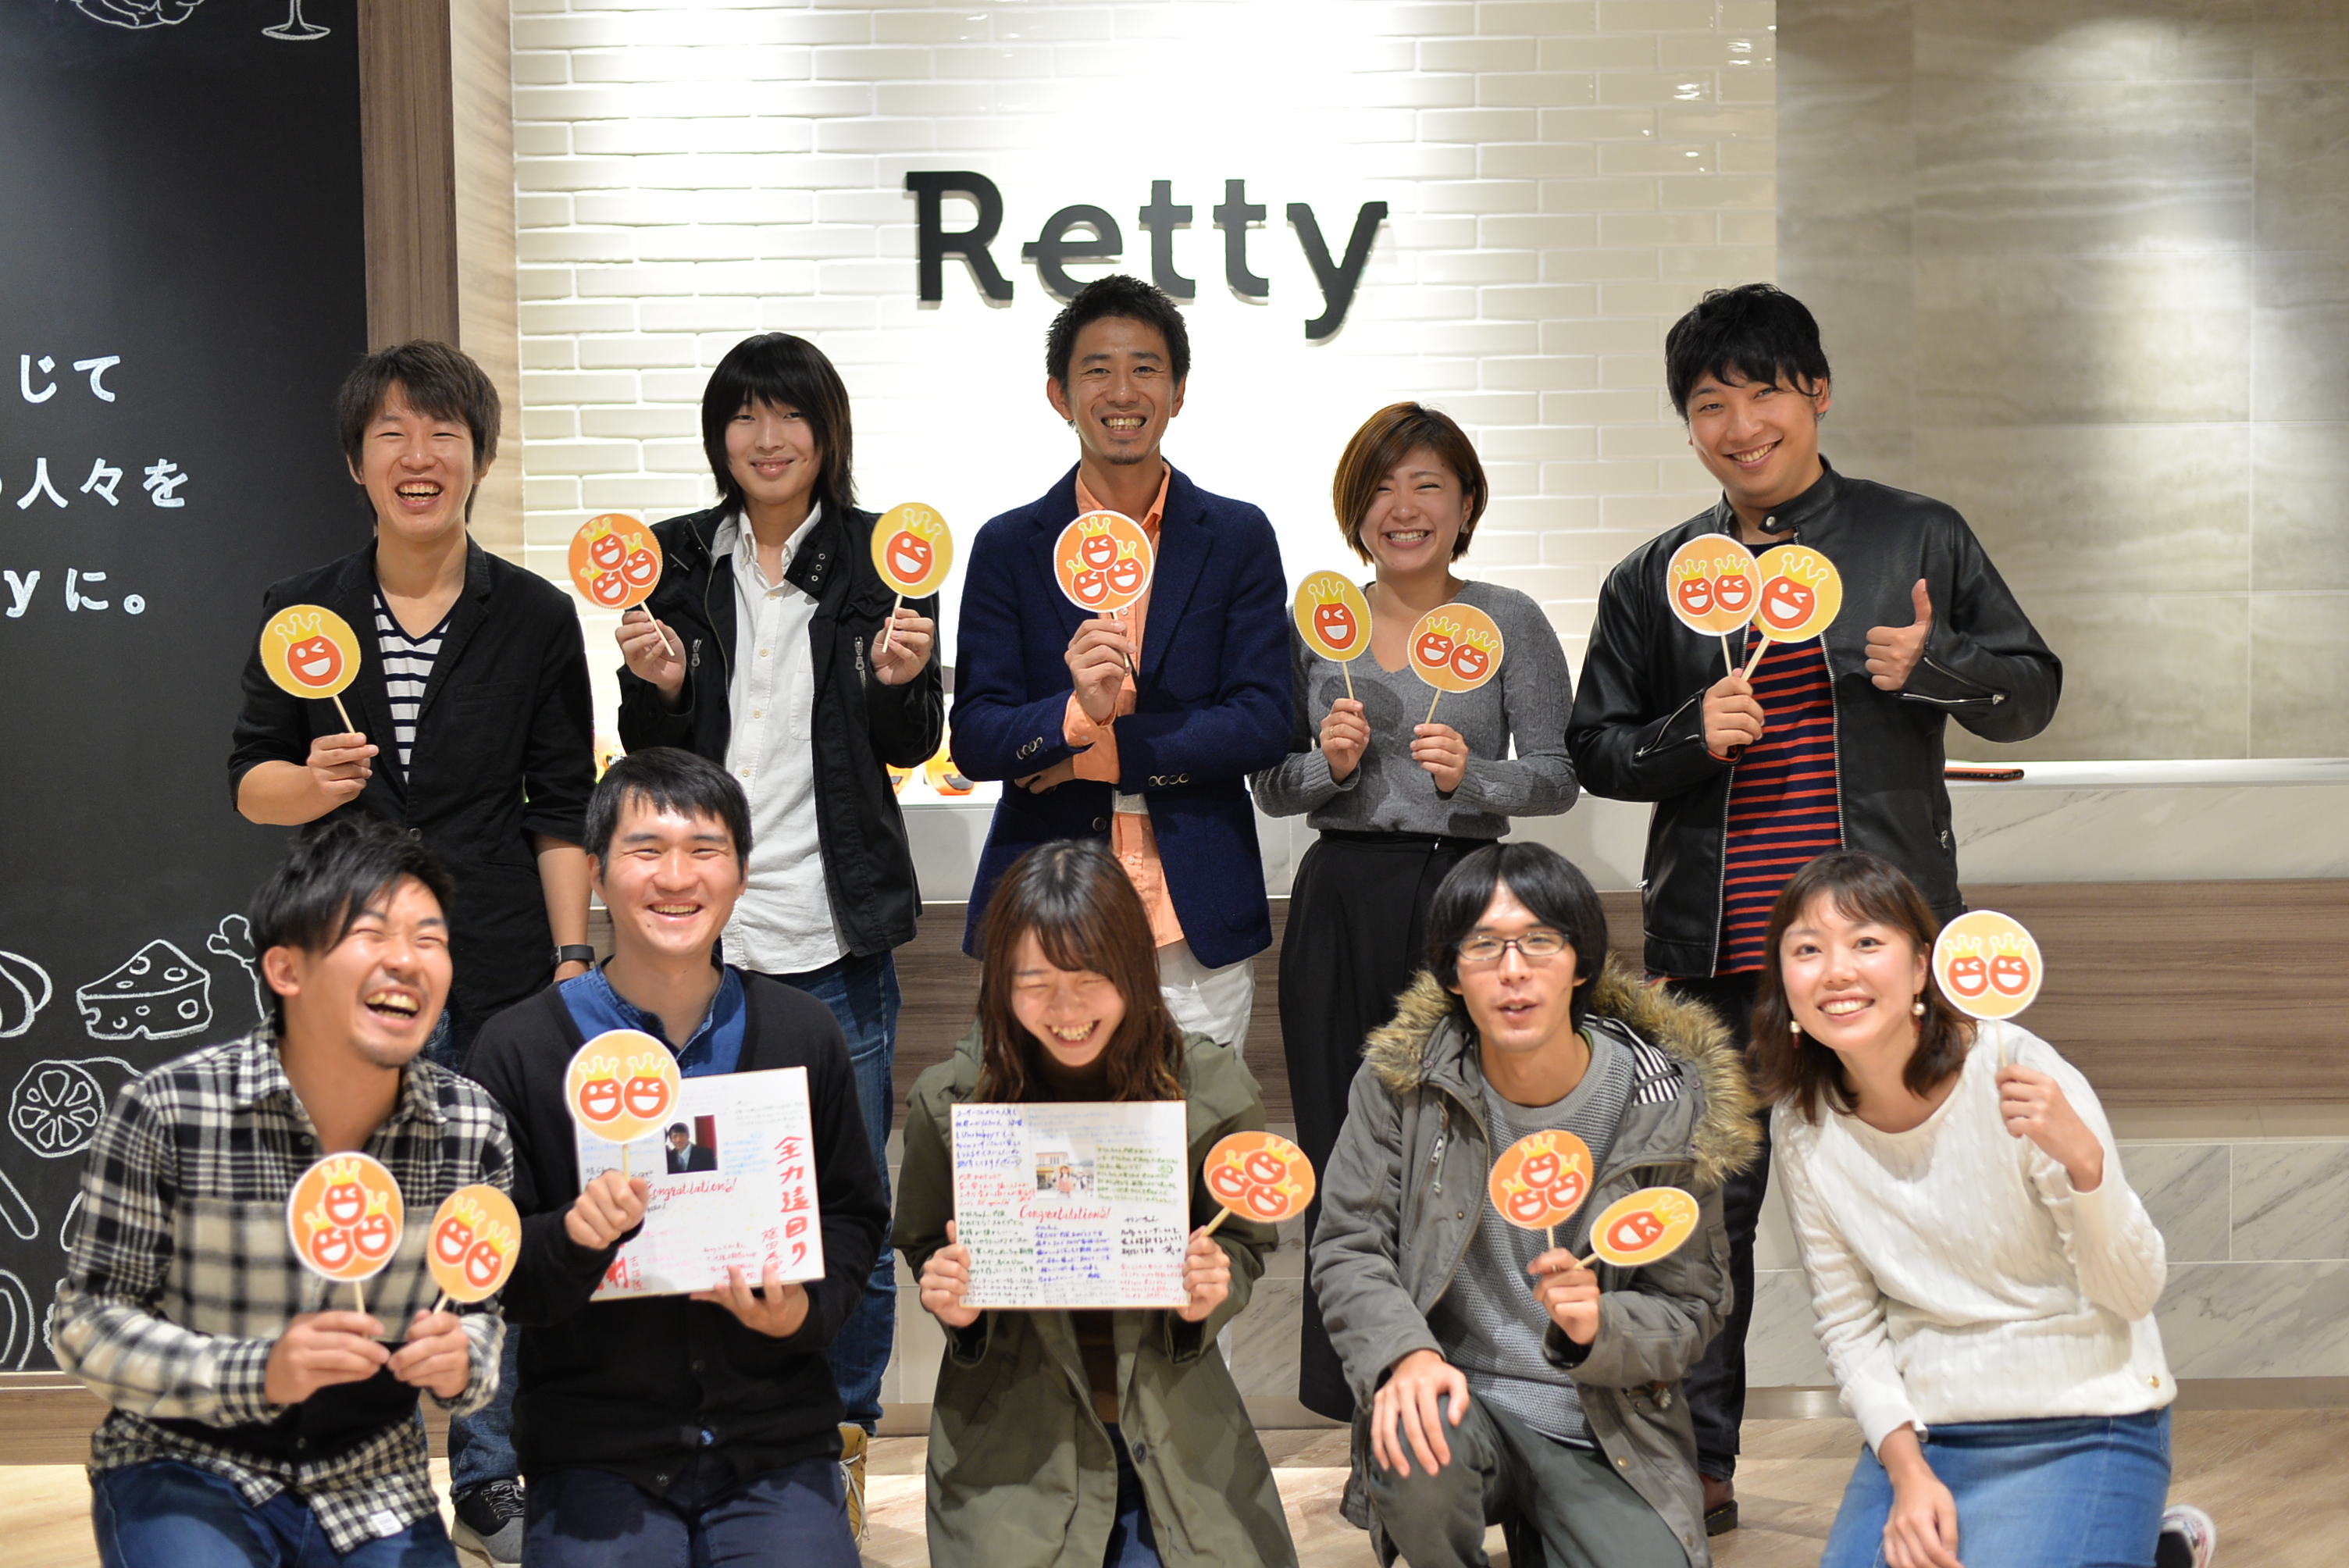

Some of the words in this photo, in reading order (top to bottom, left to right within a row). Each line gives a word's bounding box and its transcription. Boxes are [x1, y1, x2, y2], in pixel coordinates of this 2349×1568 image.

[906, 170, 1388, 344] Retty
[20, 354, 121, 404] じて
[0, 457, 189, 509] 人々を
